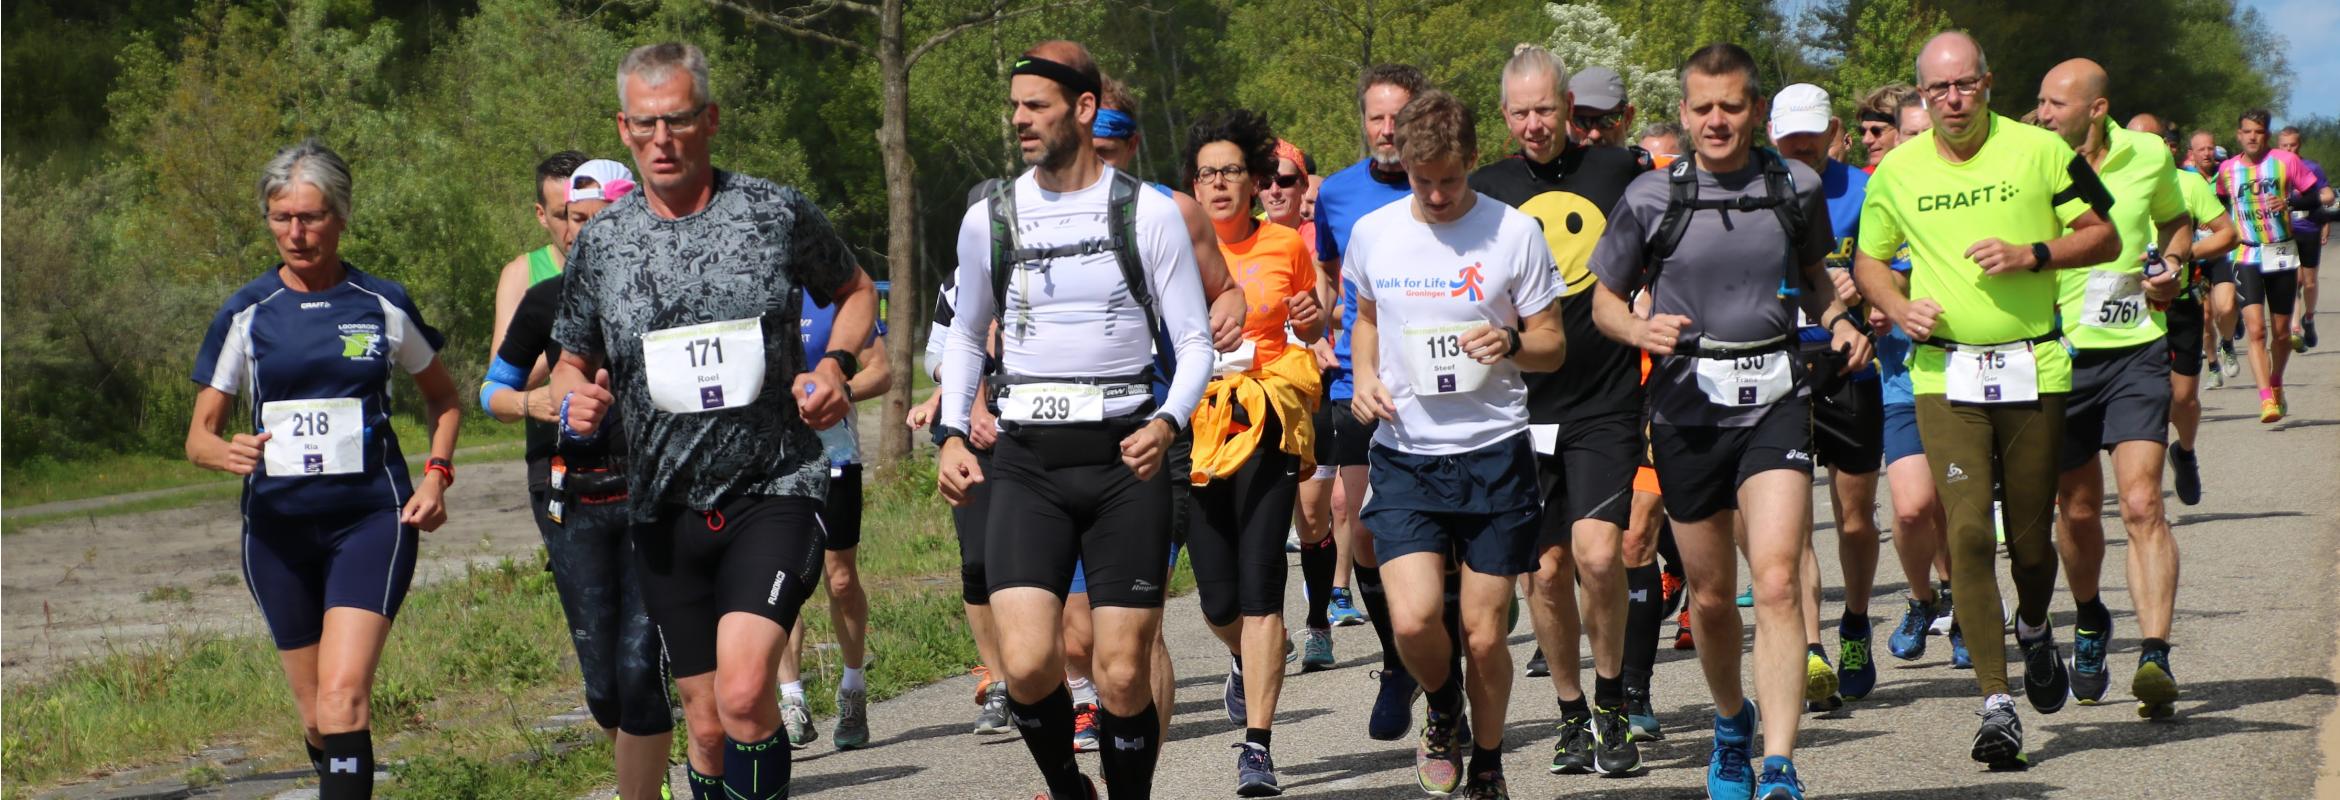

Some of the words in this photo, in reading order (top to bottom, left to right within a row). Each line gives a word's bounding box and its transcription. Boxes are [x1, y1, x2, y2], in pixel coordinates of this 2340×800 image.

[1918, 185, 1996, 212] CRAFT
[1376, 278, 1401, 289] Walk
[1404, 278, 1421, 289] for
[1424, 278, 1446, 289] Life
[1406, 290, 1446, 298] Groningen
[301, 301, 325, 310] CRAFT
[2099, 300, 2139, 323] 5761
[685, 337, 724, 368] 171
[1427, 335, 1460, 359] 113
[1976, 352, 2006, 370] 115
[697, 373, 720, 383] Roel
[1031, 396, 1070, 420] 239
[292, 411, 329, 437] 218
[690, 770, 716, 785] STO
